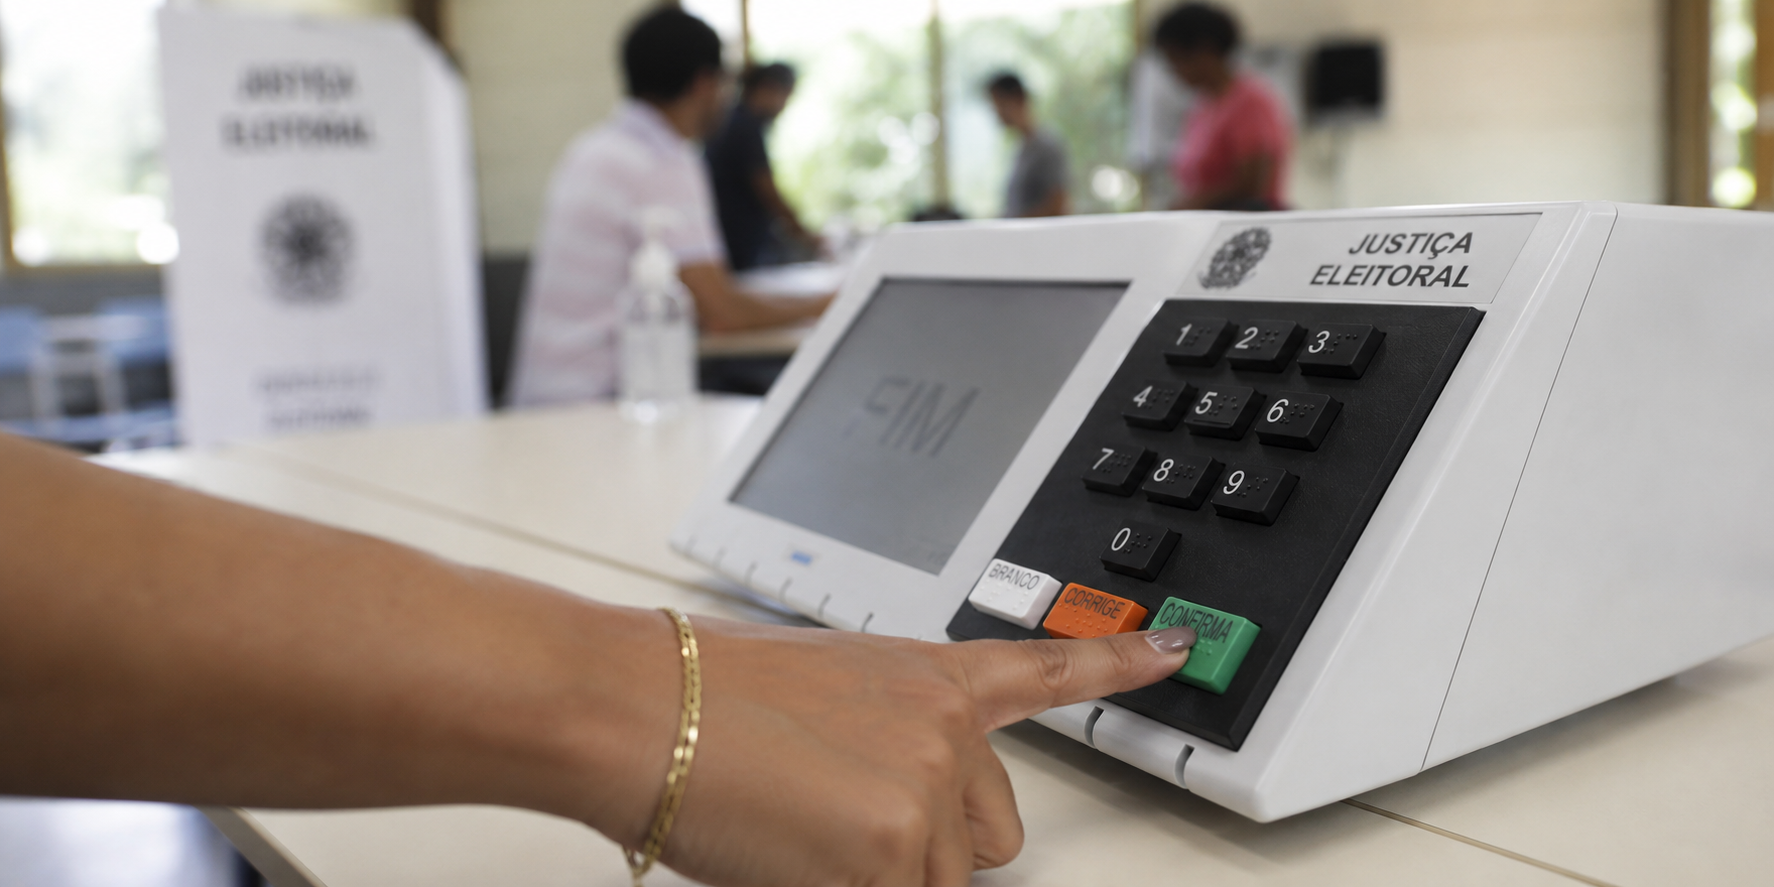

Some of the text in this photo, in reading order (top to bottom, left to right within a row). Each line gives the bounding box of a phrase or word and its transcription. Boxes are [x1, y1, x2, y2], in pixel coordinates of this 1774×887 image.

[1348, 232, 1473, 260] JUSTIÇA
[1309, 265, 1471, 288] ELEITORAL
[1176, 324, 1192, 346] 1
[1235, 327, 1258, 349] 2
[1308, 330, 1330, 354] 3
[1133, 386, 1153, 407] 4
[1195, 391, 1218, 414] 5
[843, 374, 981, 458] FIM
[1266, 398, 1289, 422] 6
[1092, 448, 1113, 470] 7
[1153, 458, 1174, 482] 8
[1223, 470, 1245, 494] 9
[1111, 527, 1131, 551] 0
[988, 563, 1040, 590] BRANCO
[1064, 587, 1126, 620] CORRIGE
[1159, 602, 1234, 644] CONFIRMA
